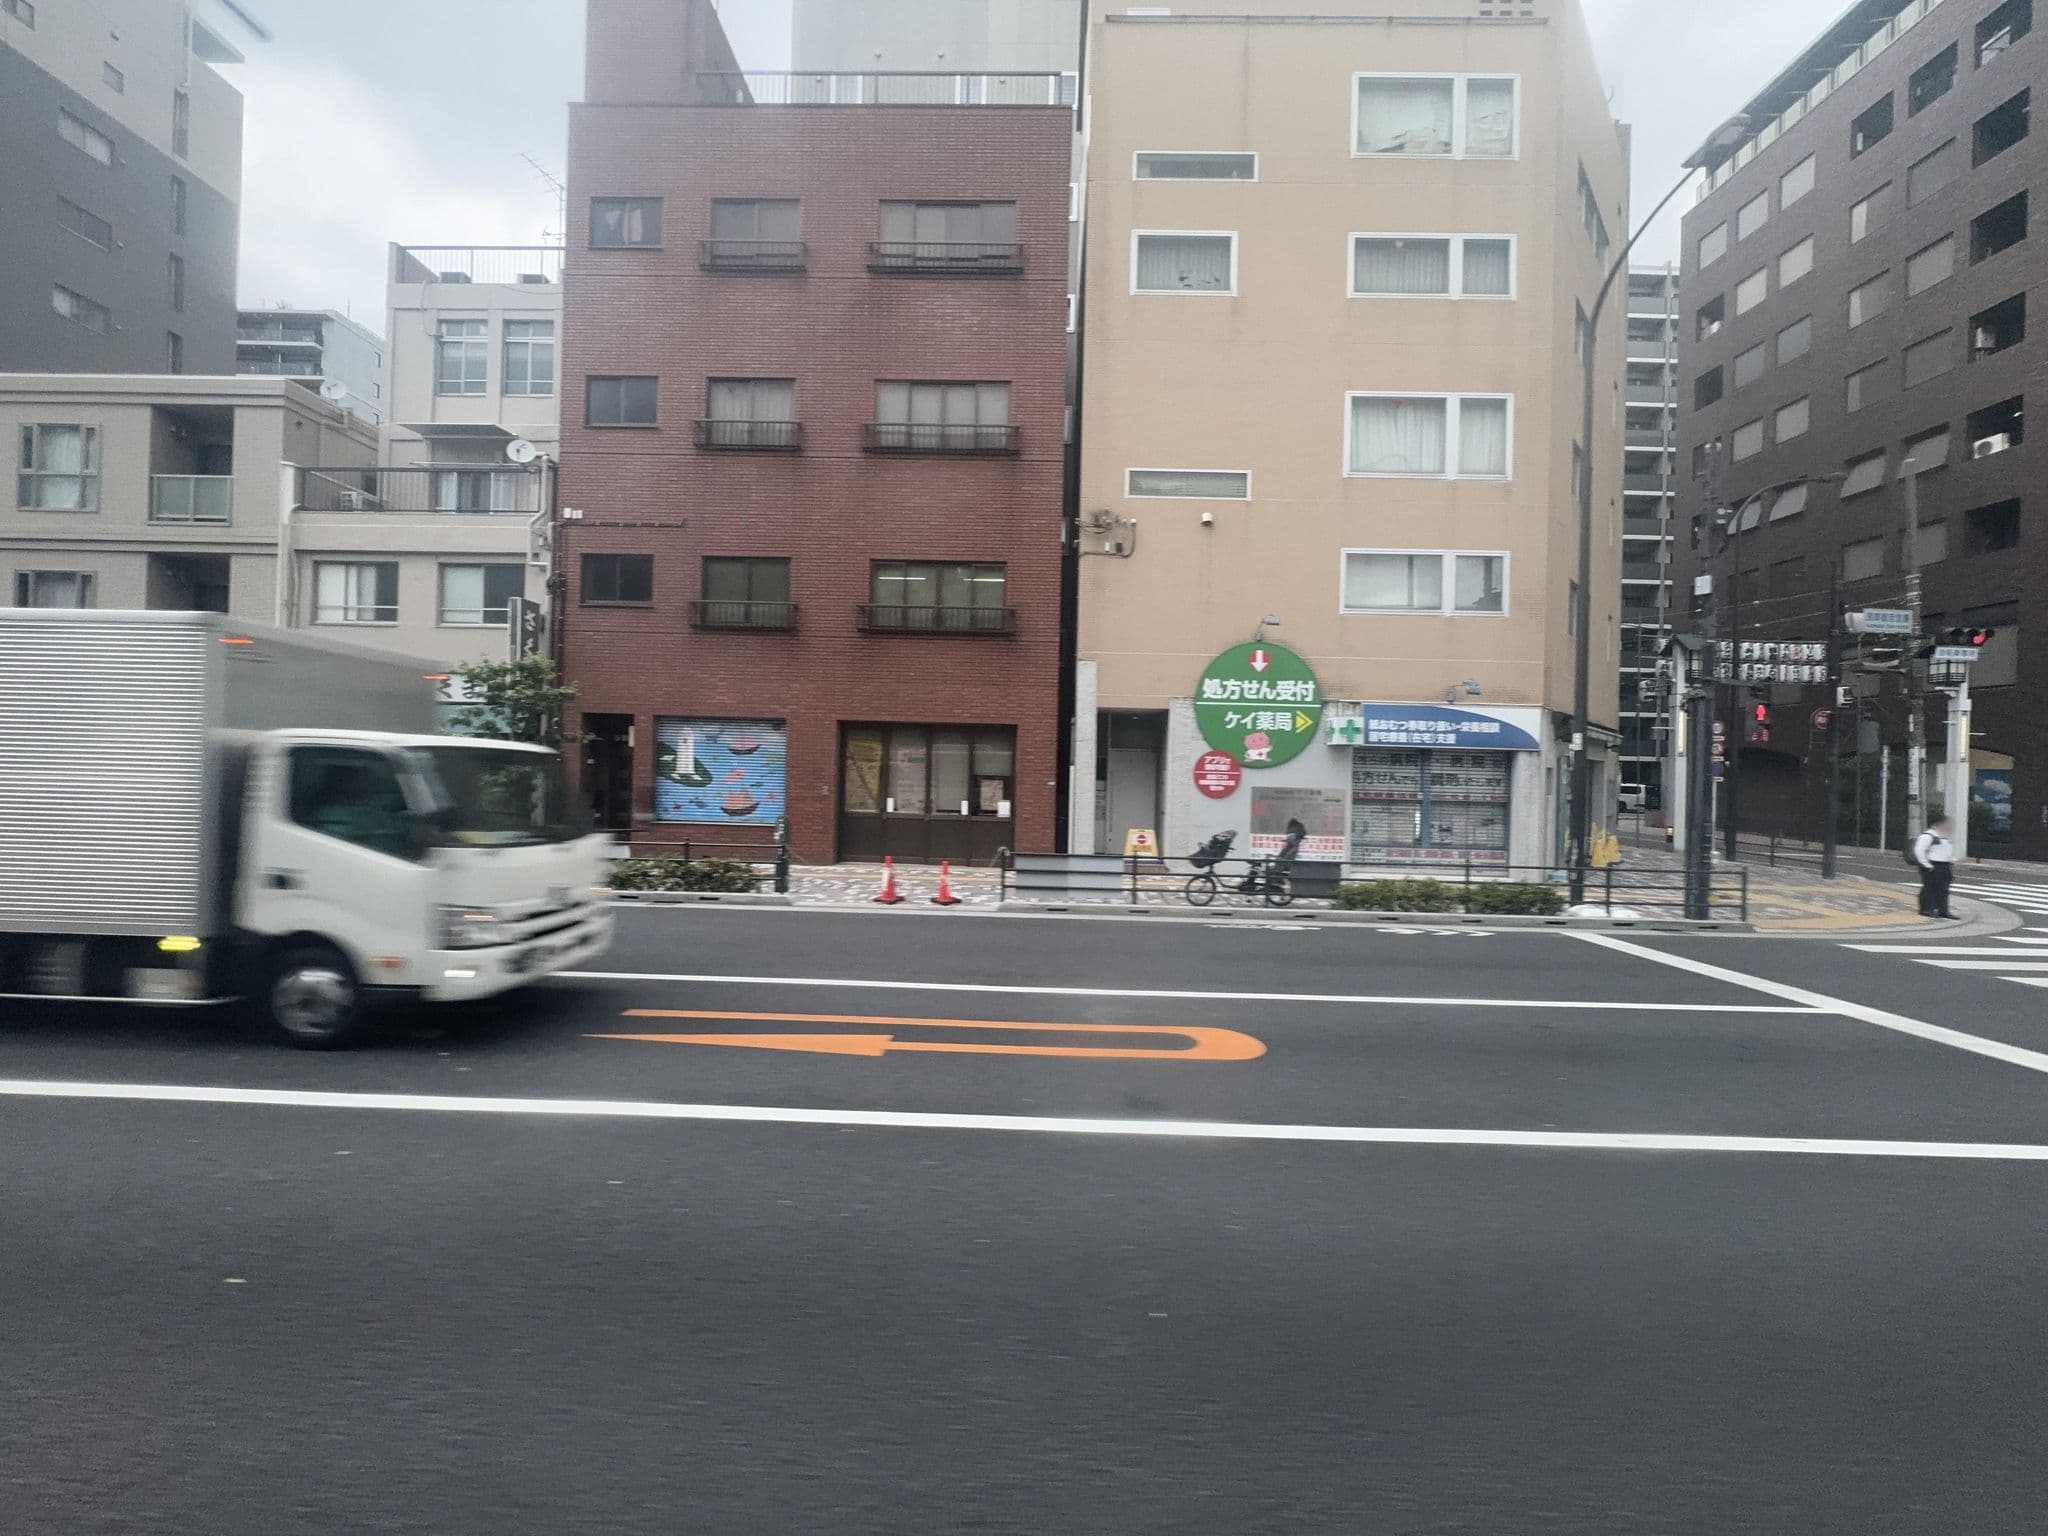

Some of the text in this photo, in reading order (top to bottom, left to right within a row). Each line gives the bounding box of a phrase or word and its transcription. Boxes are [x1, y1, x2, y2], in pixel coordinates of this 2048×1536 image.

[1202, 678, 1315, 702] 処方せん受付
[1224, 711, 1293, 731] ケイ薬局
